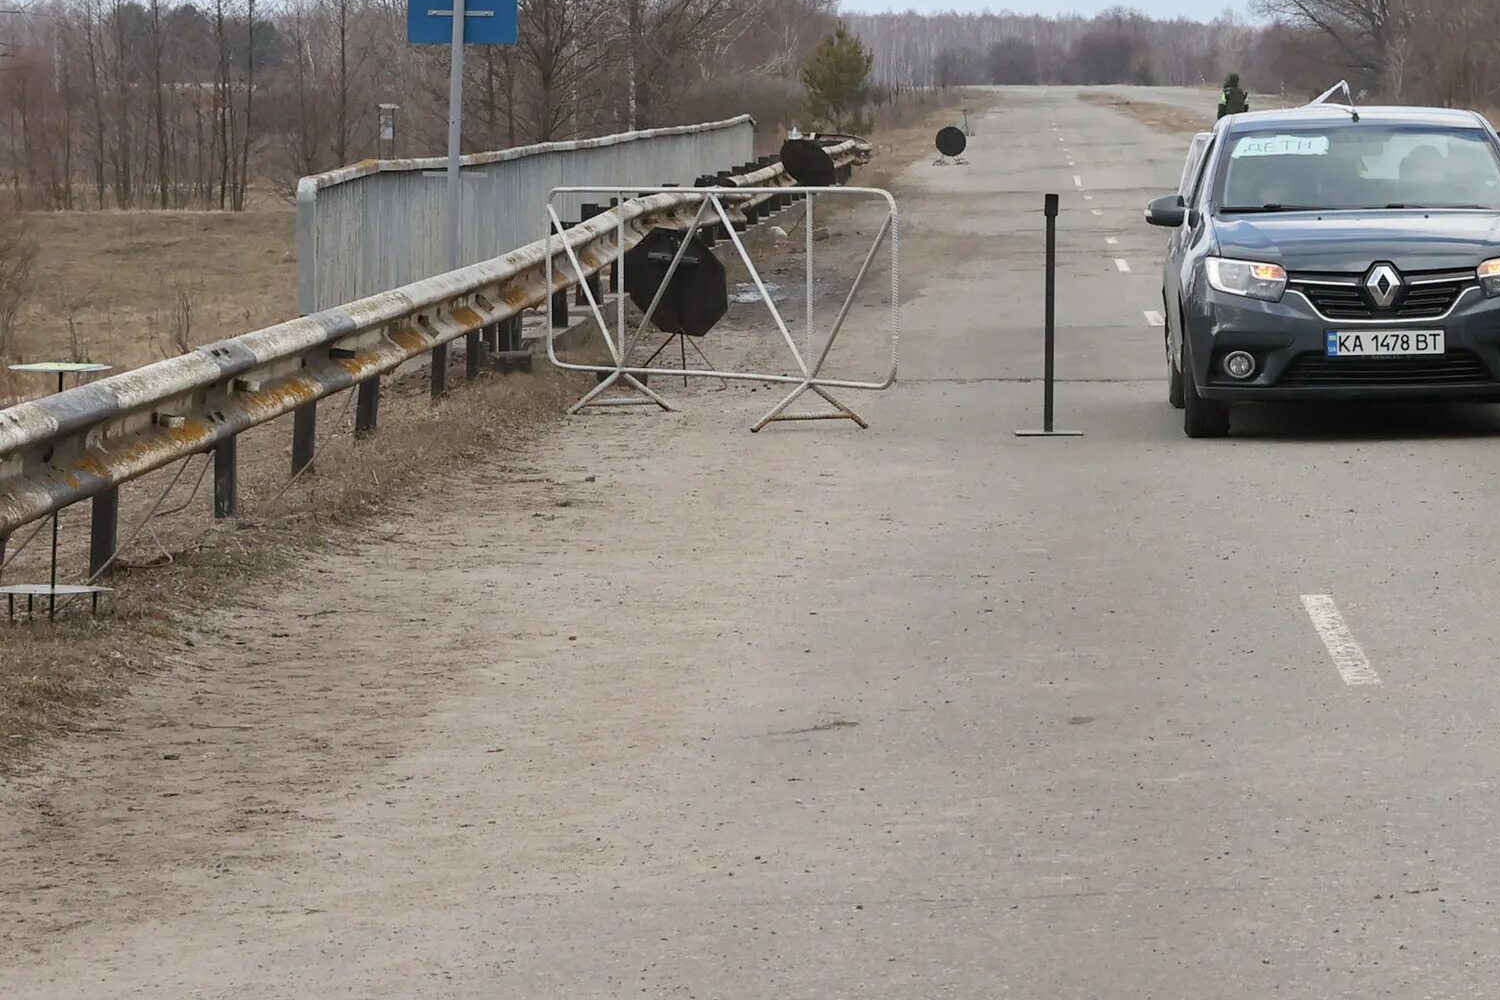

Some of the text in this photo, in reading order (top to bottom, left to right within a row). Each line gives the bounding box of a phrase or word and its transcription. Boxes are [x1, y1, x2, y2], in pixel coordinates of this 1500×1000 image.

[1243, 139, 1312, 152] ДЕТИ
[1338, 333, 1441, 352] KA 1478 BT
